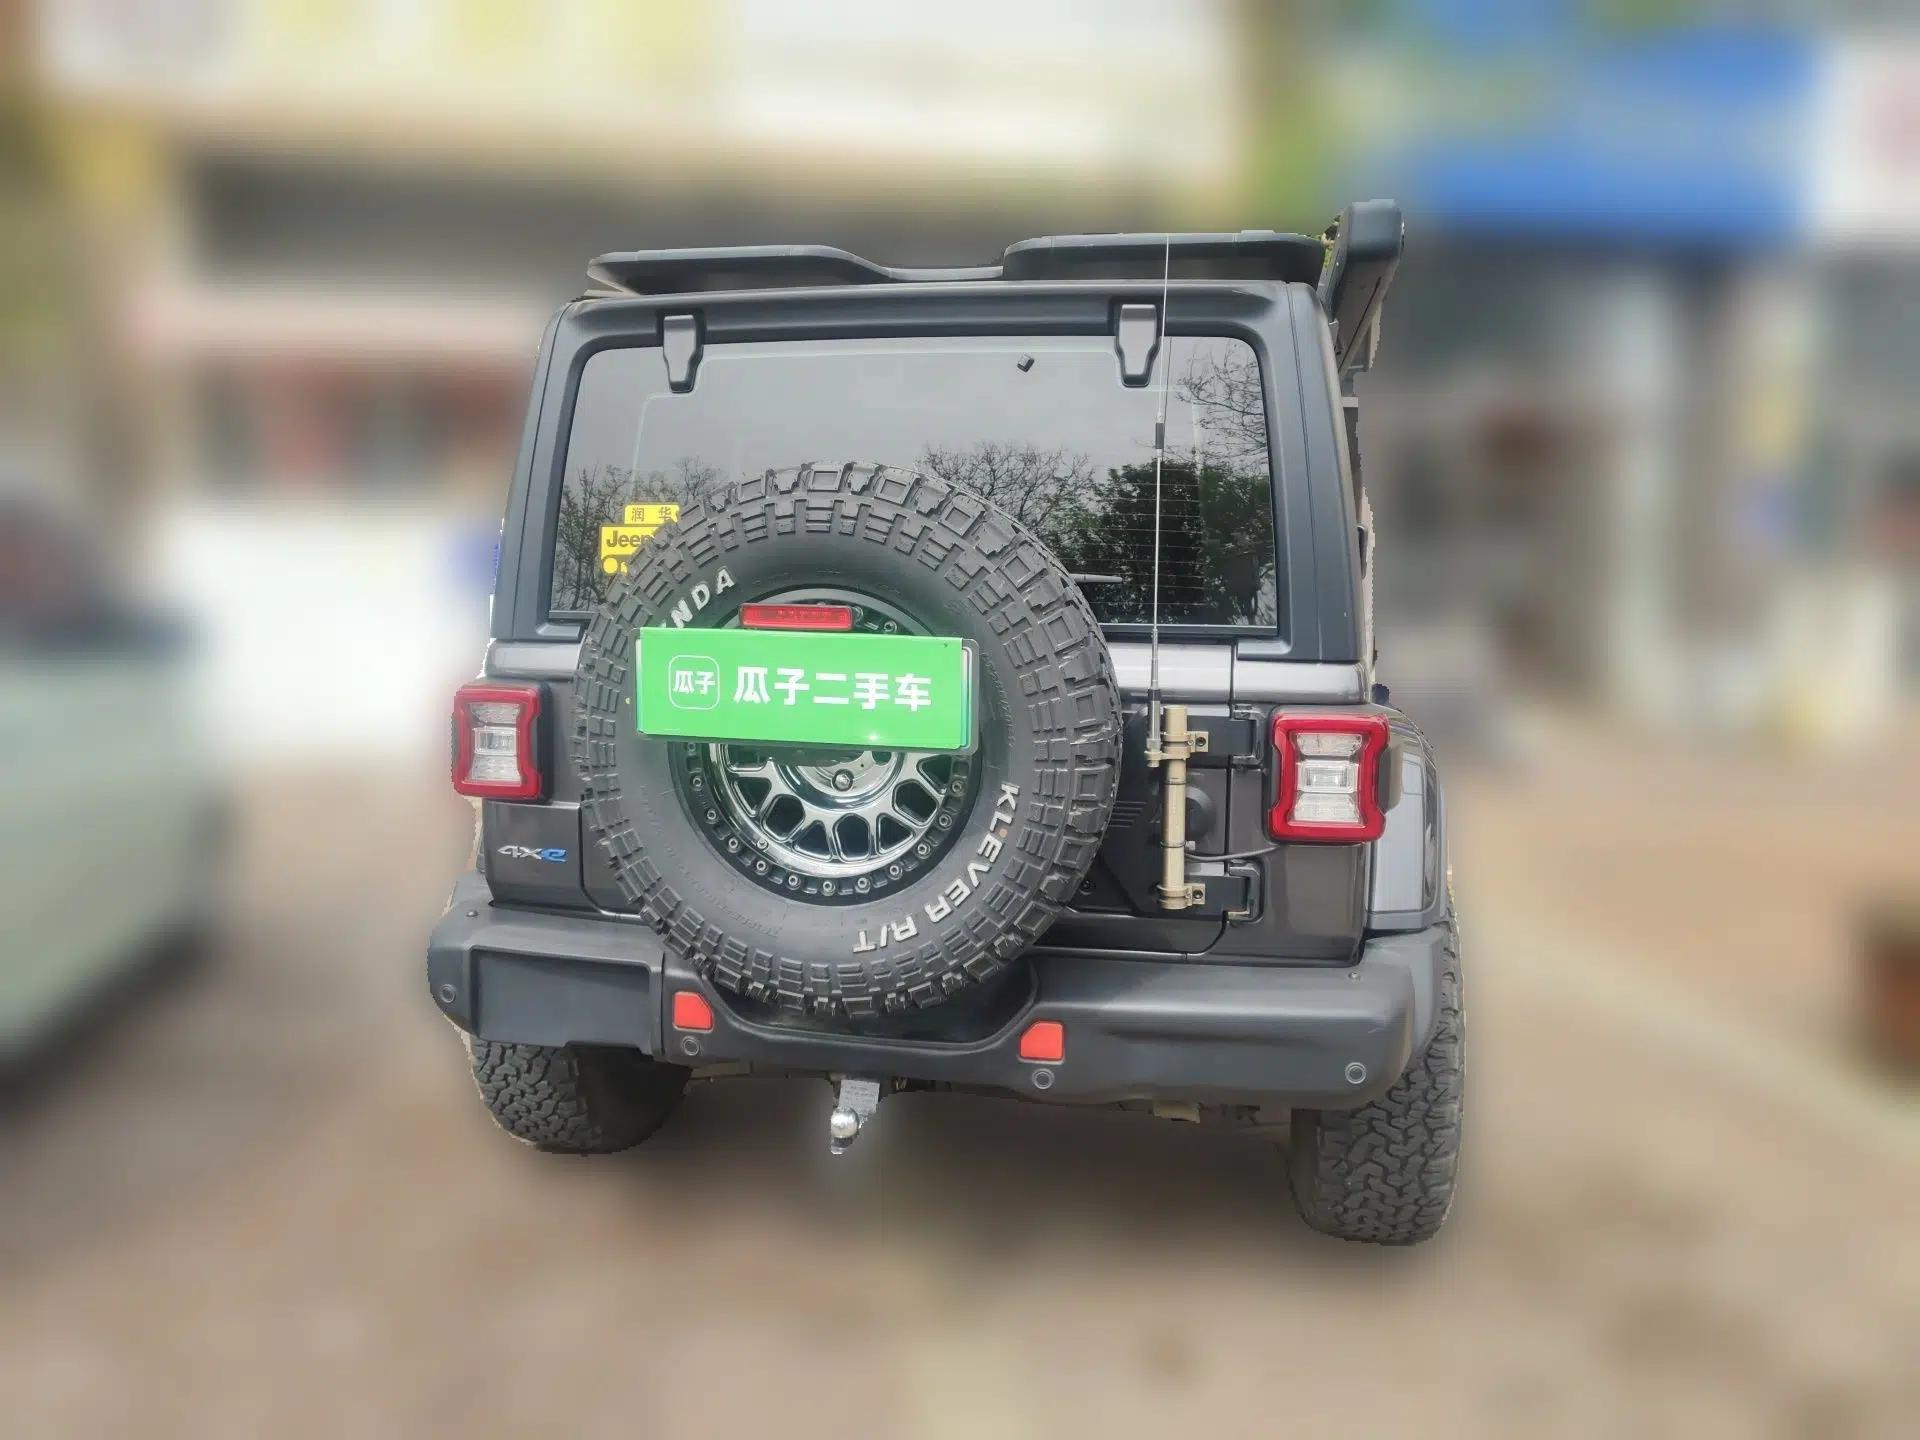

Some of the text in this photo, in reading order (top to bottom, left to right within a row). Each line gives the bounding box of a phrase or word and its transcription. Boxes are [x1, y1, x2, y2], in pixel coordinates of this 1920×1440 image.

[661, 568, 735, 629] NDA
[673, 670, 715, 695] 瓜子
[733, 665, 932, 712] 瓜子二手车
[853, 783, 1019, 953] KLEVER R/T
